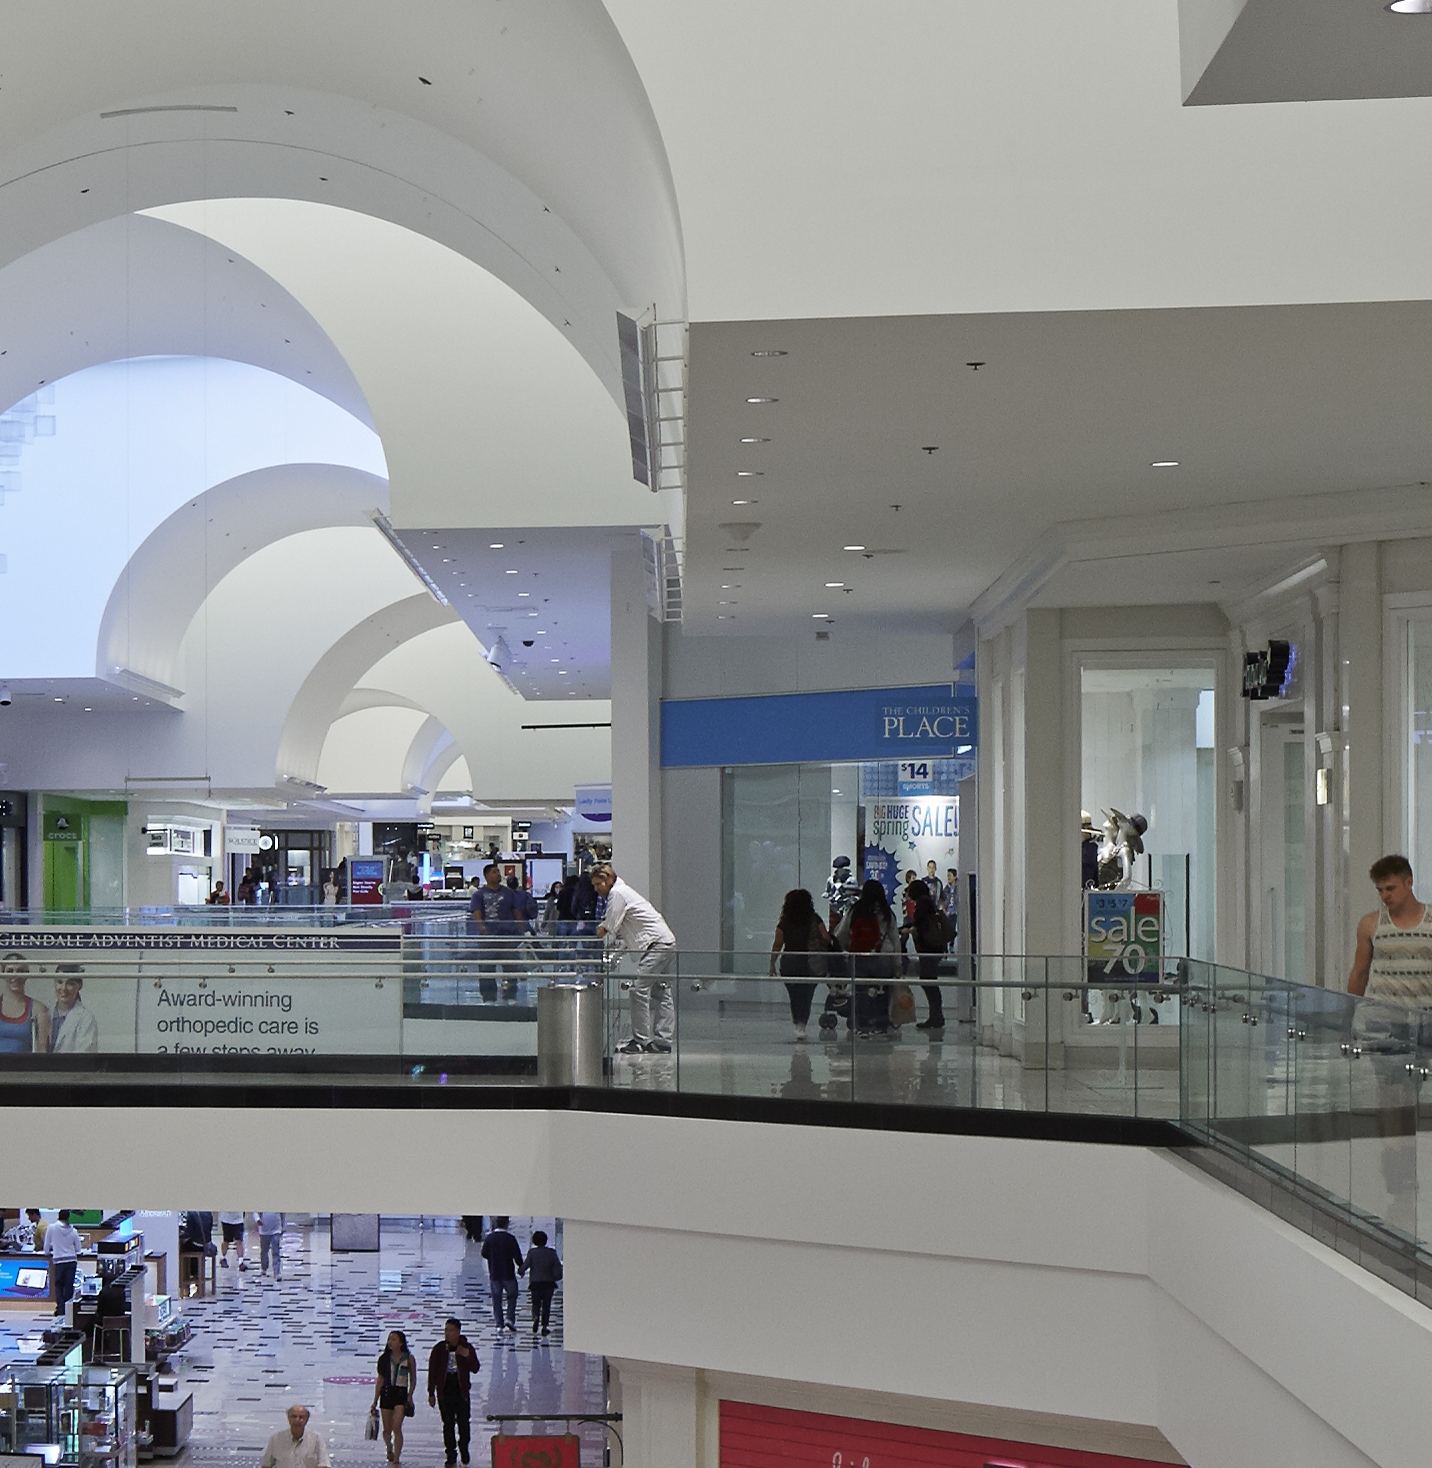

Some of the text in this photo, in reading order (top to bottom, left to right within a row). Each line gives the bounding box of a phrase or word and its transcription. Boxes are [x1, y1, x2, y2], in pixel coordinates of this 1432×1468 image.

[882, 705, 970, 715] THE CHILDREN'S
[882, 716, 970, 738] PLACE
[901, 762, 929, 780] $14
[887, 804, 910, 820] HUGE
[873, 819, 910, 842] spring
[1090, 906, 1160, 943] sale
[157, 989, 292, 1013] Award-winning
[157, 1016, 320, 1037] orthopedic care is
